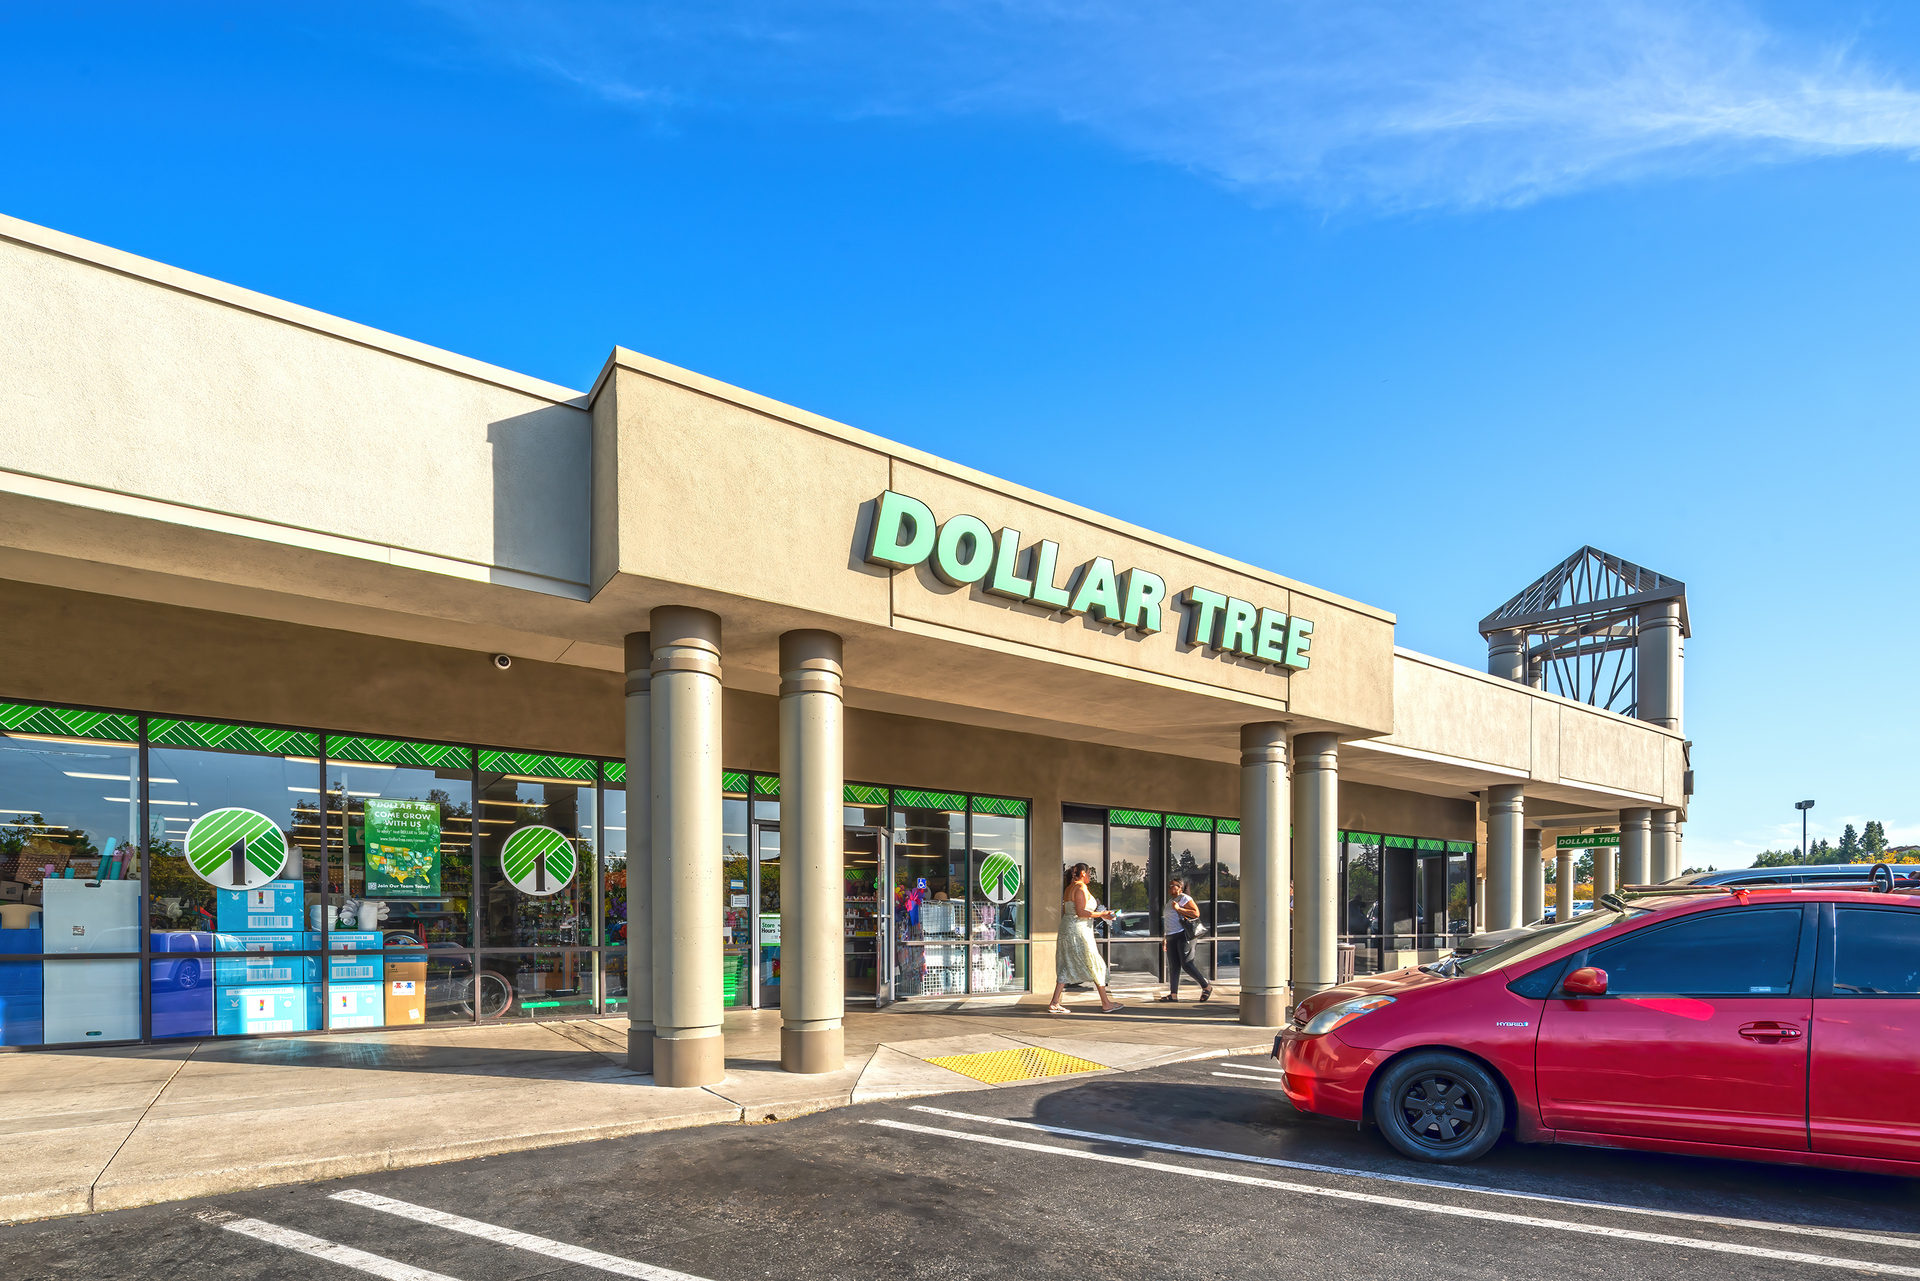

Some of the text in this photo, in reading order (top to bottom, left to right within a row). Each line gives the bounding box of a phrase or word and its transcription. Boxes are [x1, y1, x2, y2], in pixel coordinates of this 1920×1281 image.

[865, 489, 1314, 669] DOLLAR TREE
[414, 803, 436, 811] TREE
[402, 812, 431, 820] GROW
